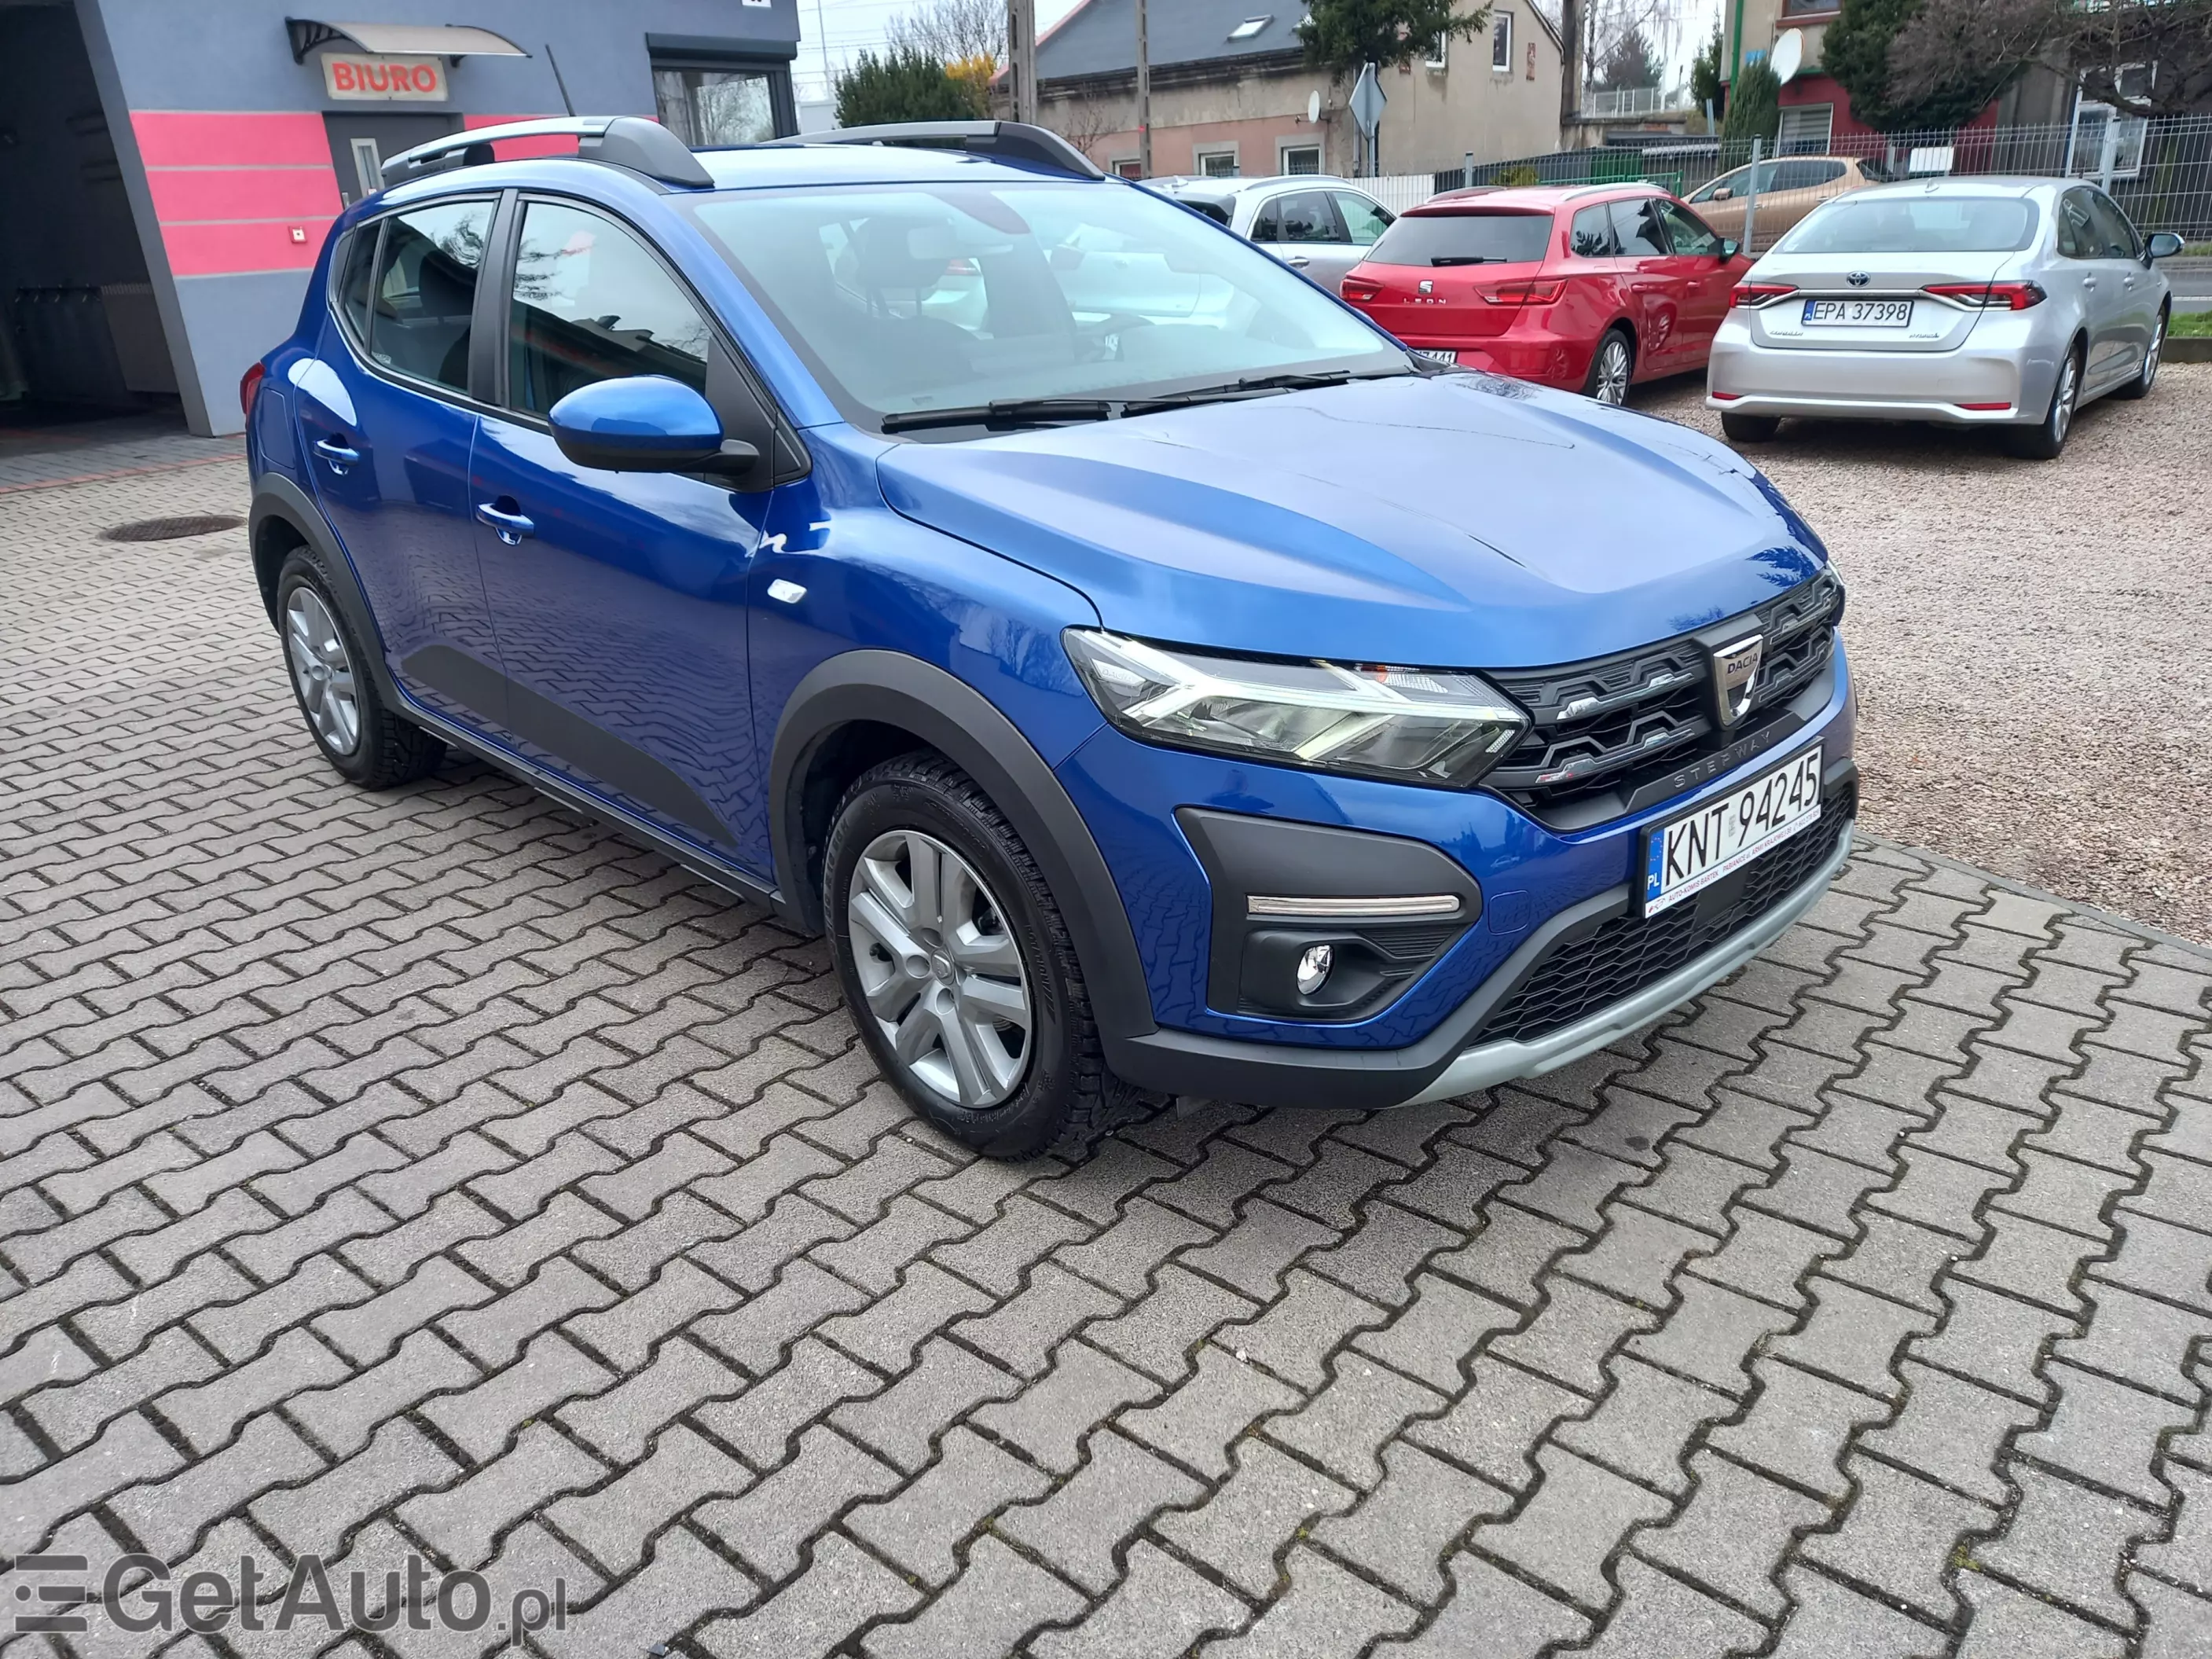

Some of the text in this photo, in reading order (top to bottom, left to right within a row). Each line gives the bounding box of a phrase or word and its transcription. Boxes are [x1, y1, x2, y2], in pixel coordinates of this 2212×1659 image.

[332, 61, 437, 93] BIURO
[1813, 302, 1908, 321] EPA 37398
[1728, 653, 1758, 674] DACIA
[1674, 731, 1770, 788] STEPWAY
[1665, 752, 1819, 886] KNT 94245
[1647, 872, 1660, 890] PL
[1700, 870, 1719, 885] BARTEK
